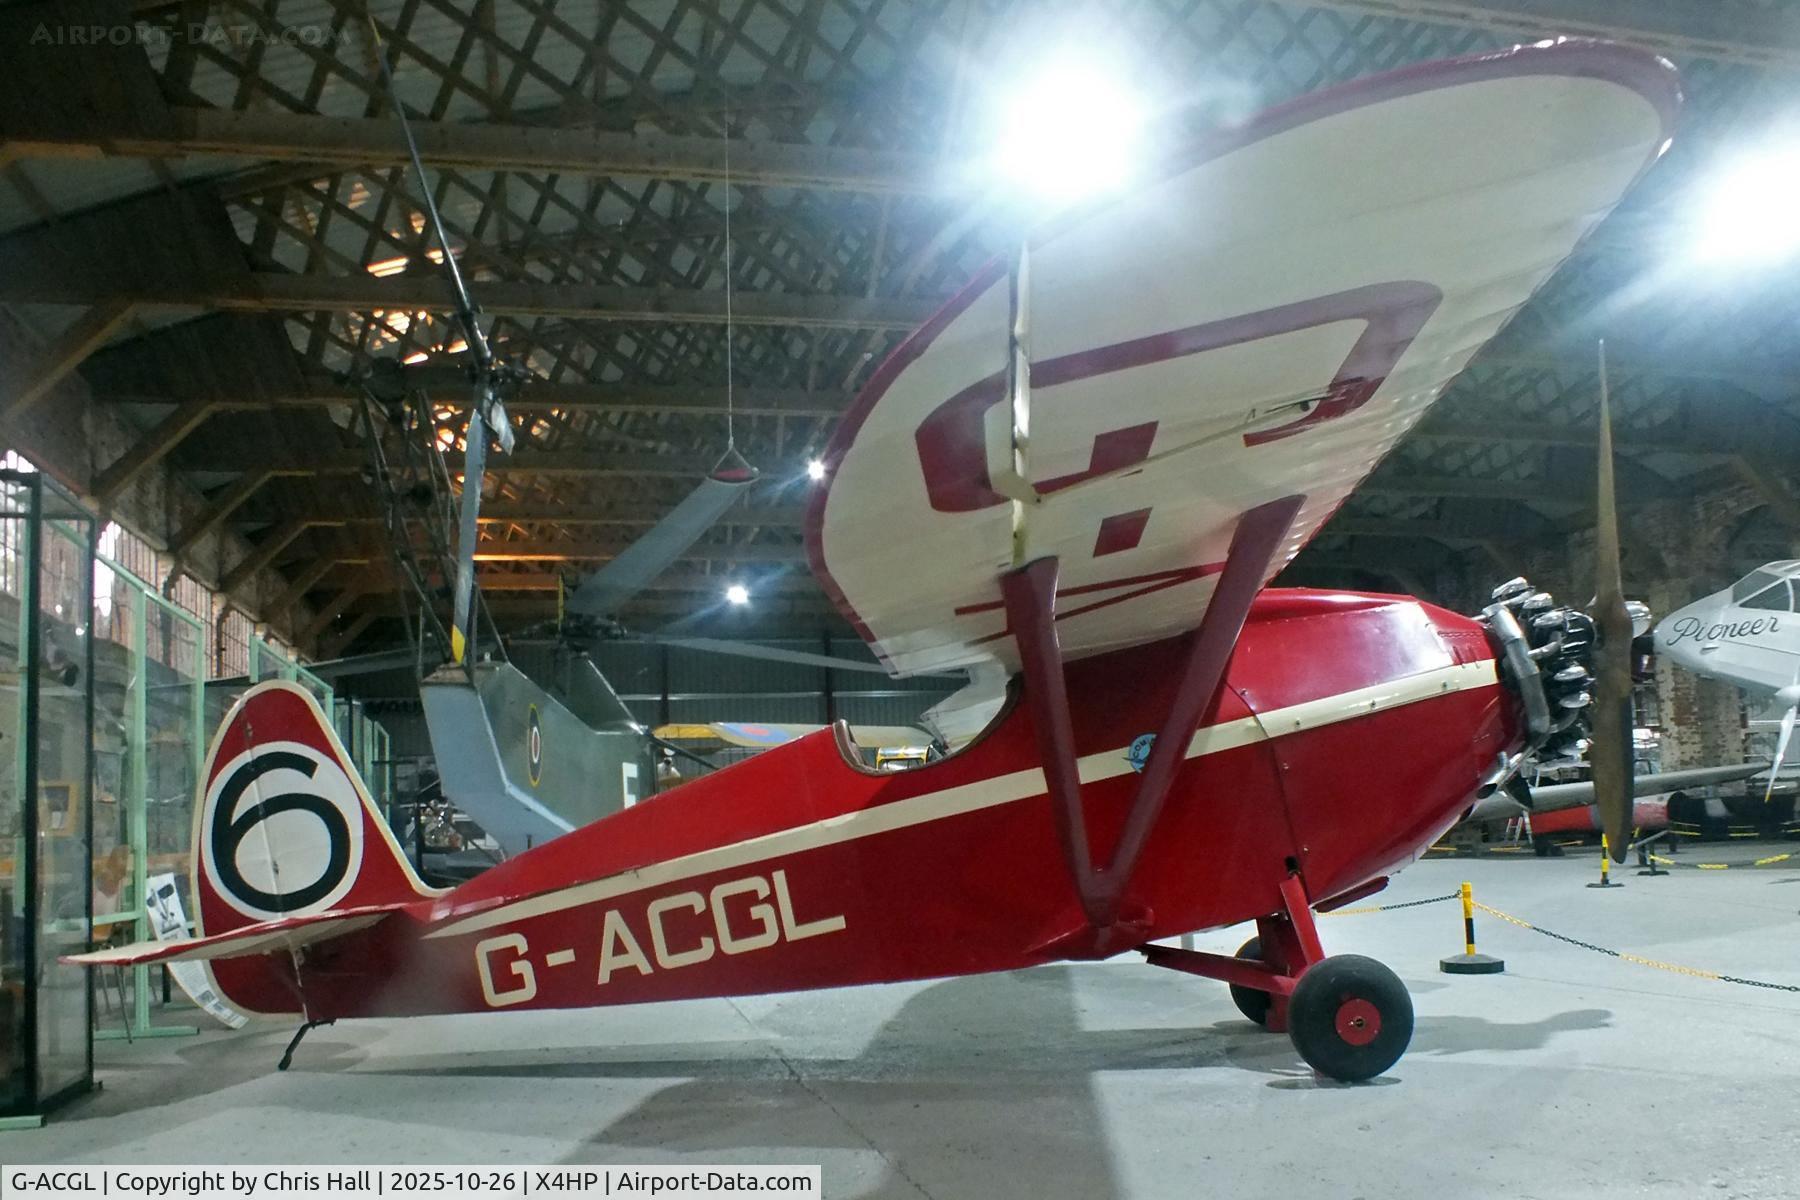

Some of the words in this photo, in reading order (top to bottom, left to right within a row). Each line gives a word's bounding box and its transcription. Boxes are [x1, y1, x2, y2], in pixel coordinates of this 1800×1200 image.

[1666, 616, 1780, 646] Pioneer
[212, 751, 351, 912] 6
[474, 869, 847, 1008] G-ACGL
